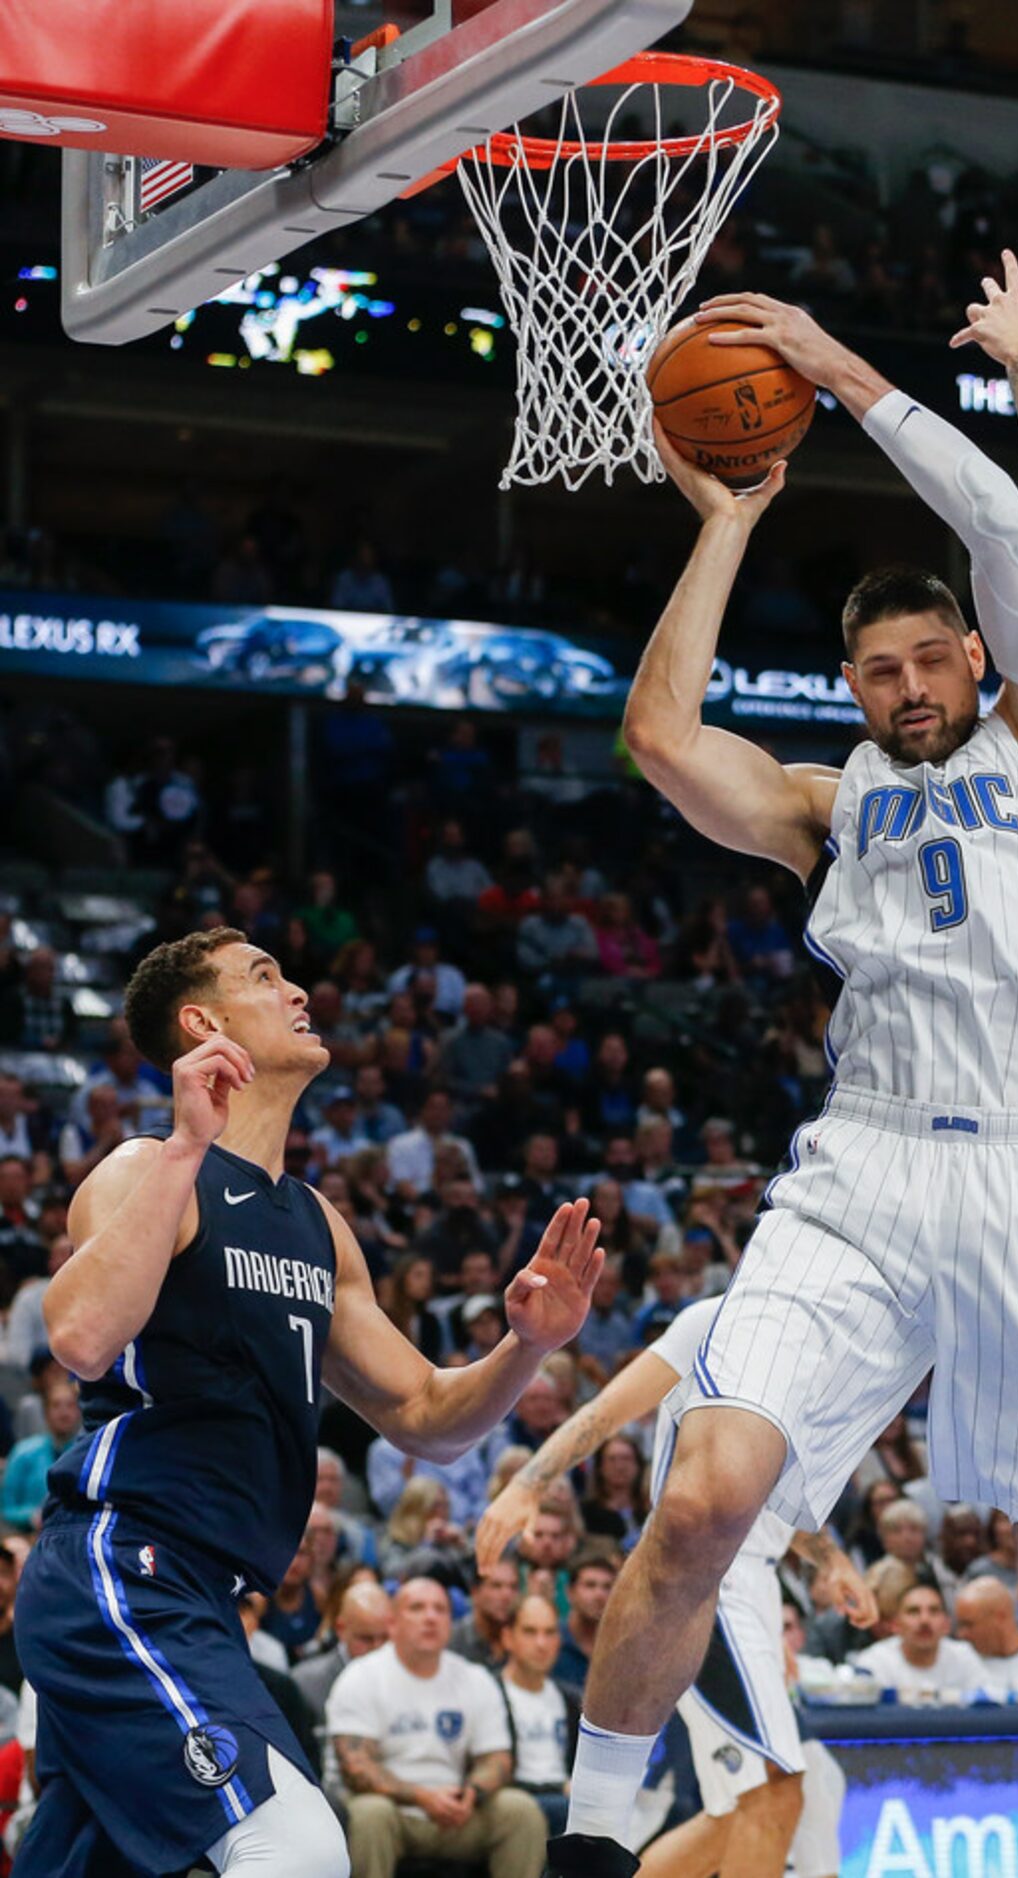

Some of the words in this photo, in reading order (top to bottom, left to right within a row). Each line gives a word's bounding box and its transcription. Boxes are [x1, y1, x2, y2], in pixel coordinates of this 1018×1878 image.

[956, 374, 1017, 415] THE
[0, 614, 94, 654] LEXUS
[97, 620, 140, 657] RX
[734, 668, 857, 704] LEXU
[918, 836, 969, 933] 9
[223, 1246, 335, 1315] MAVERICK
[288, 1314, 314, 1404] 7
